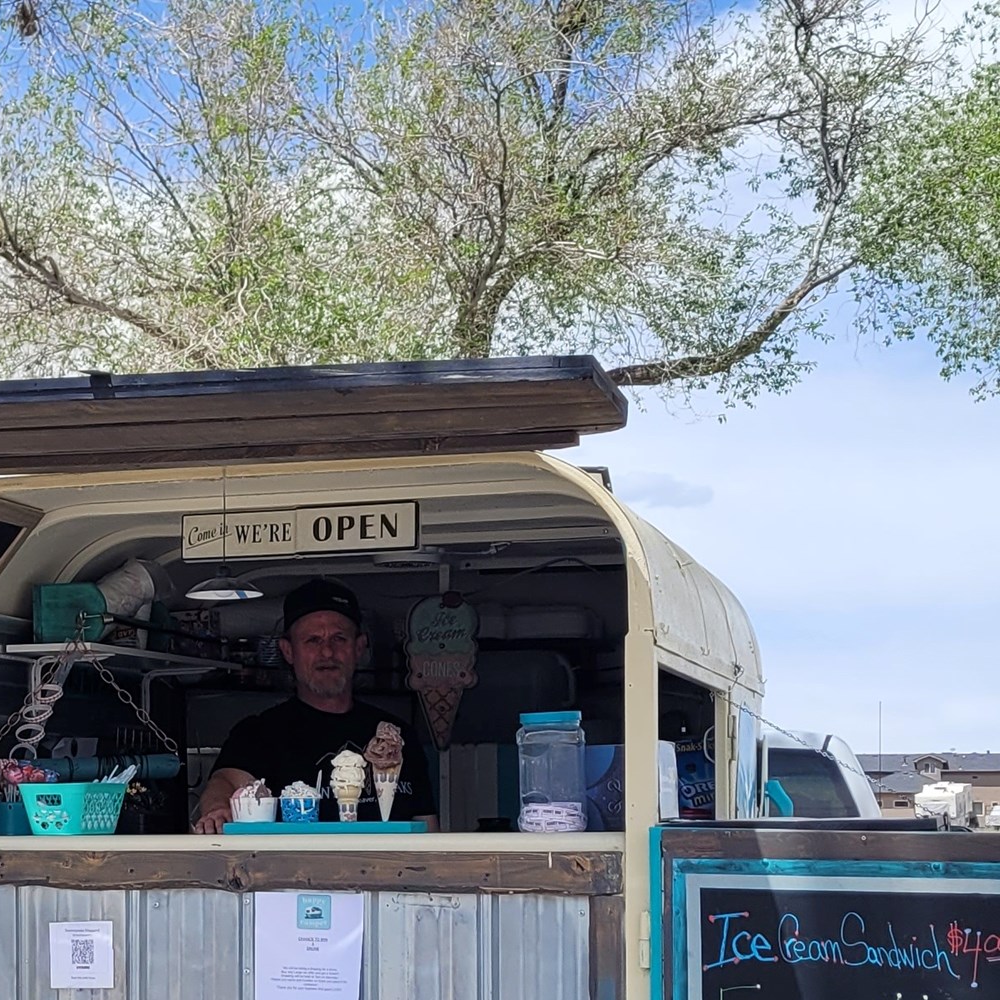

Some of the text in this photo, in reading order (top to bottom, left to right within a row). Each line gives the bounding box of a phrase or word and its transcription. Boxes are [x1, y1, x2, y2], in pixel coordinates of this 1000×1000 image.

[187, 526, 217, 546] Come
[235, 522, 292, 544] WE'RE
[312, 512, 399, 542] OPEN
[430, 611, 457, 627] Ice
[416, 626, 472, 643] Cream
[422, 660, 461, 677] CONES
[680, 781, 715, 798] ORE
[702, 911, 778, 971] Ice
[778, 913, 845, 965] Cream
[841, 912, 960, 979] Sandwich
